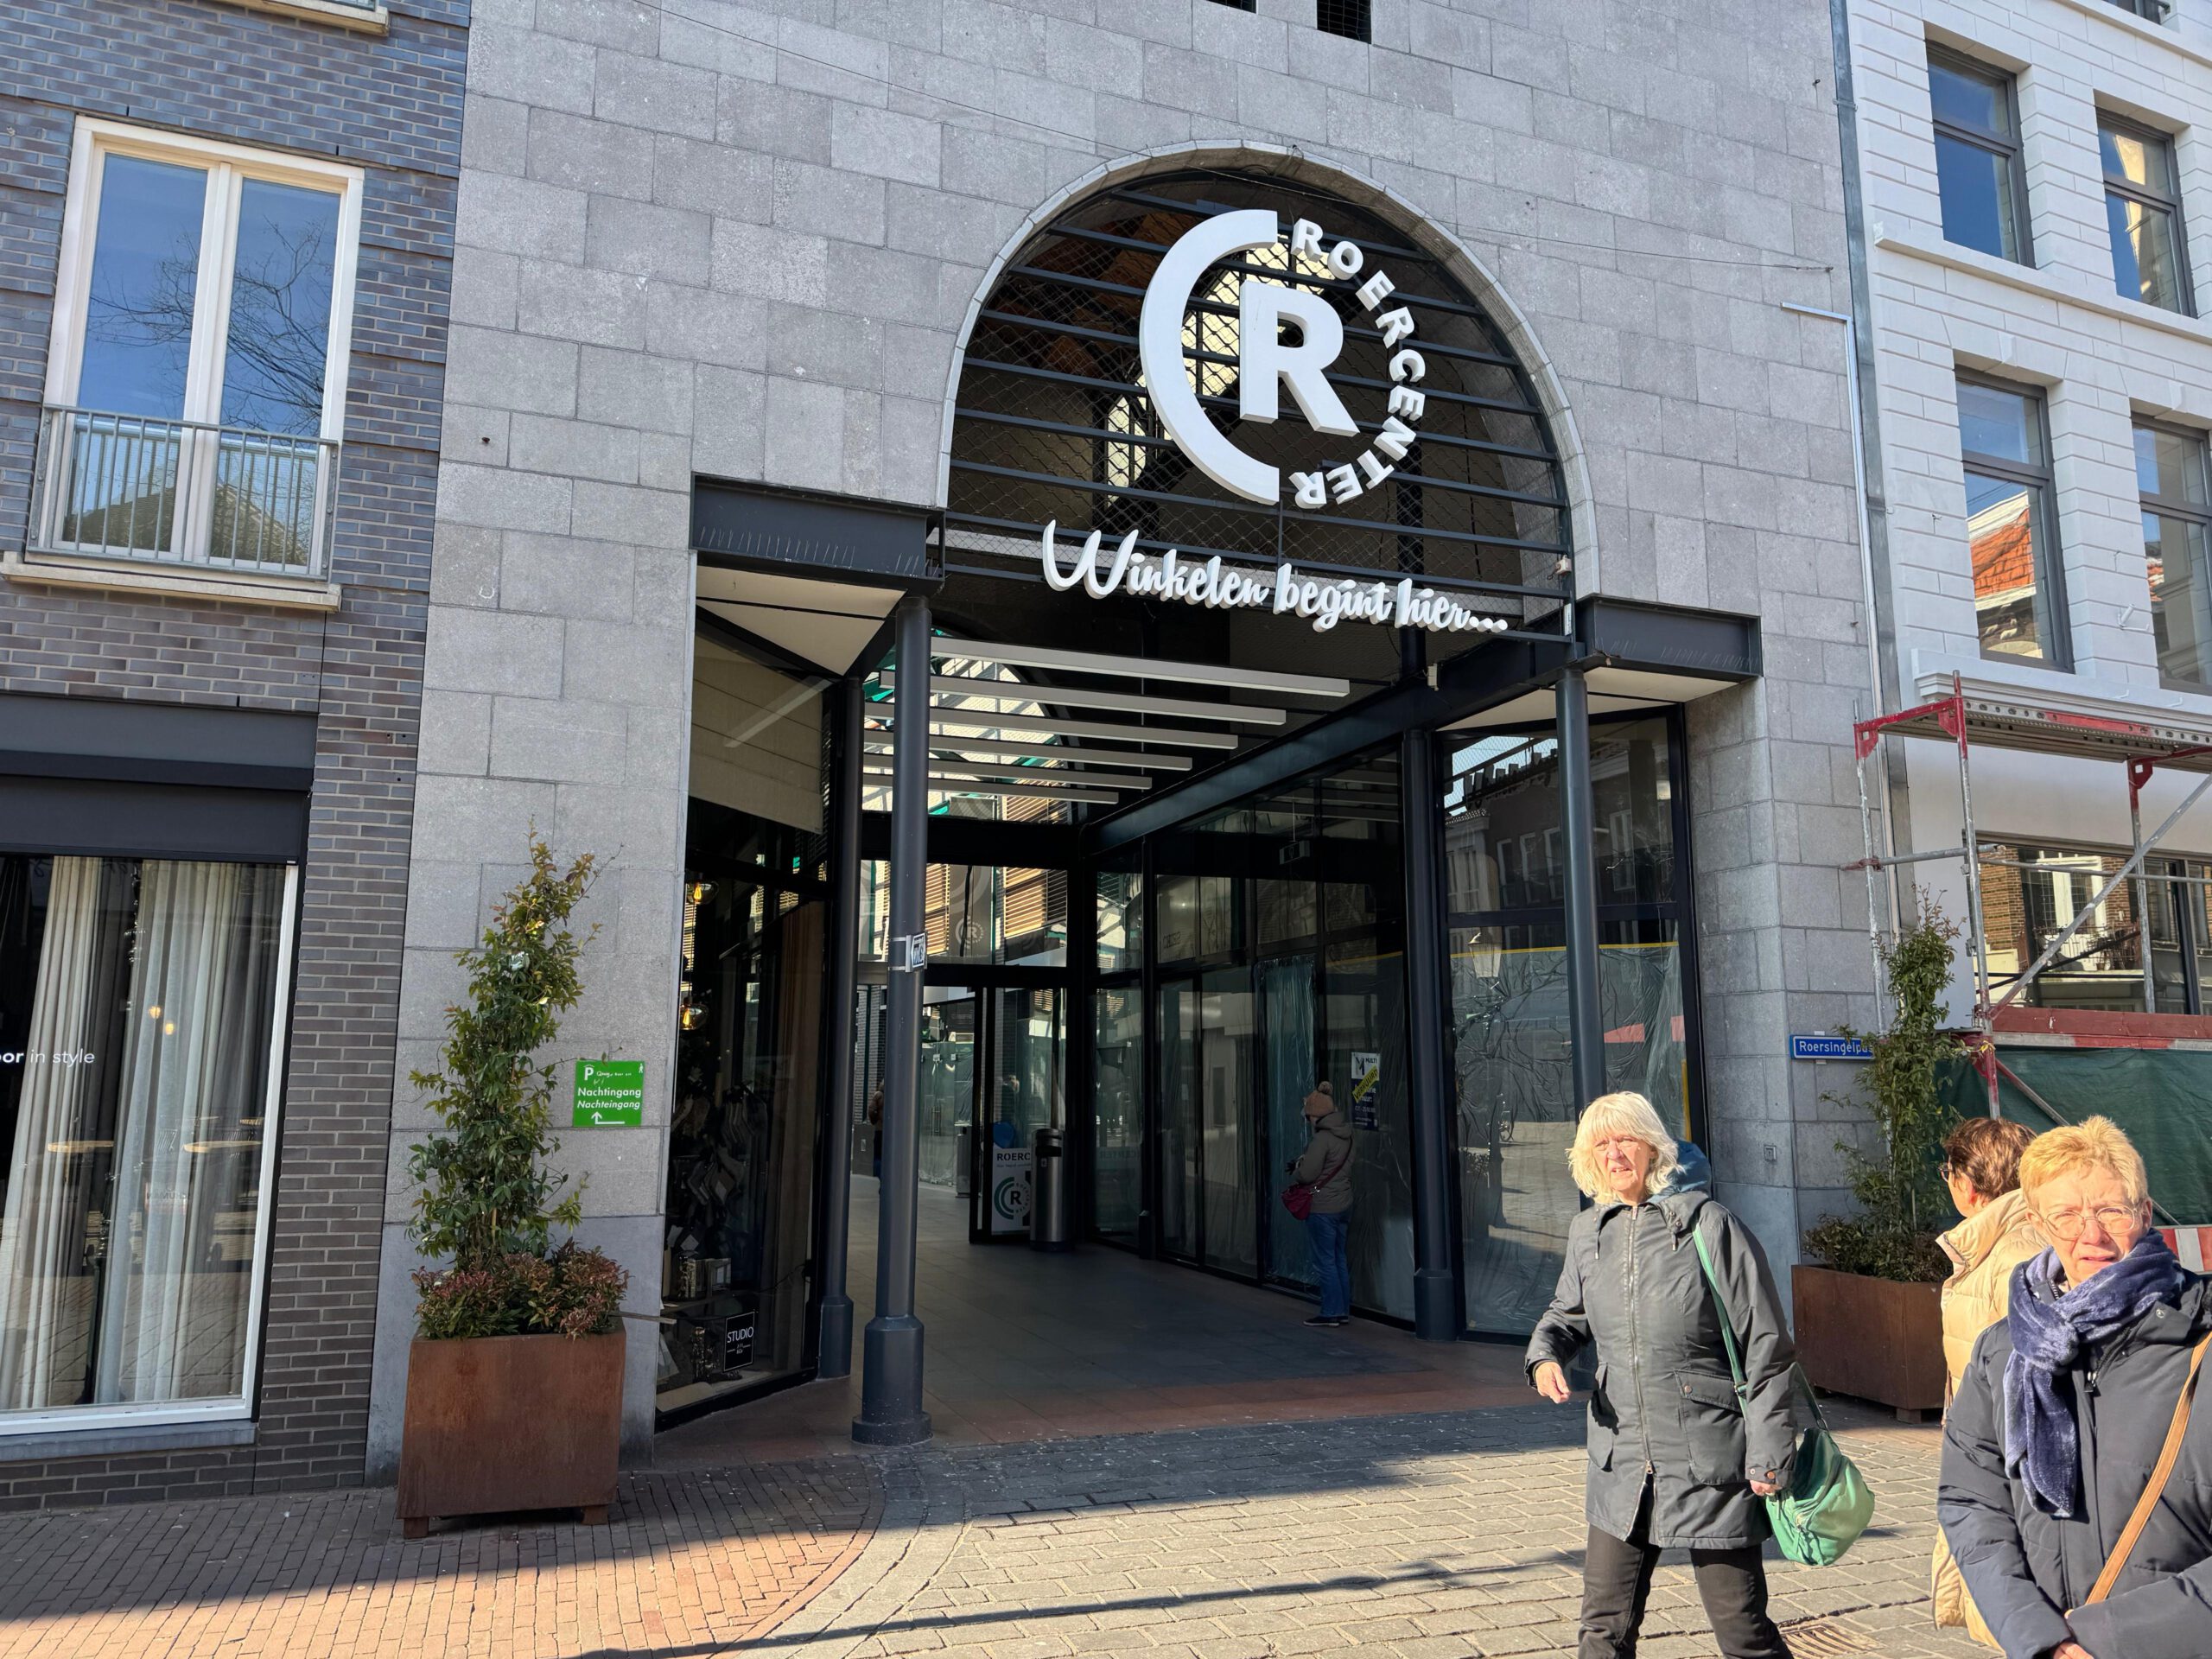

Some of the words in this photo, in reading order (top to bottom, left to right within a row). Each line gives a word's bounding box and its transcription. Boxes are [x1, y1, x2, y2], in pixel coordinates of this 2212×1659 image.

[1288, 218, 1427, 510] ROERCENTER
[1042, 518, 1270, 609] Winkelen
[1273, 563, 1393, 633] begint
[0, 1052, 24, 1064] oor
[30, 1049, 46, 1064] in
[52, 1047, 96, 1068] style
[577, 1086, 641, 1098] Nachtingang
[576, 1099, 641, 1110] Nachteingang
[996, 1152, 1031, 1161] ROERC
[727, 1326, 753, 1343] STUDIO
